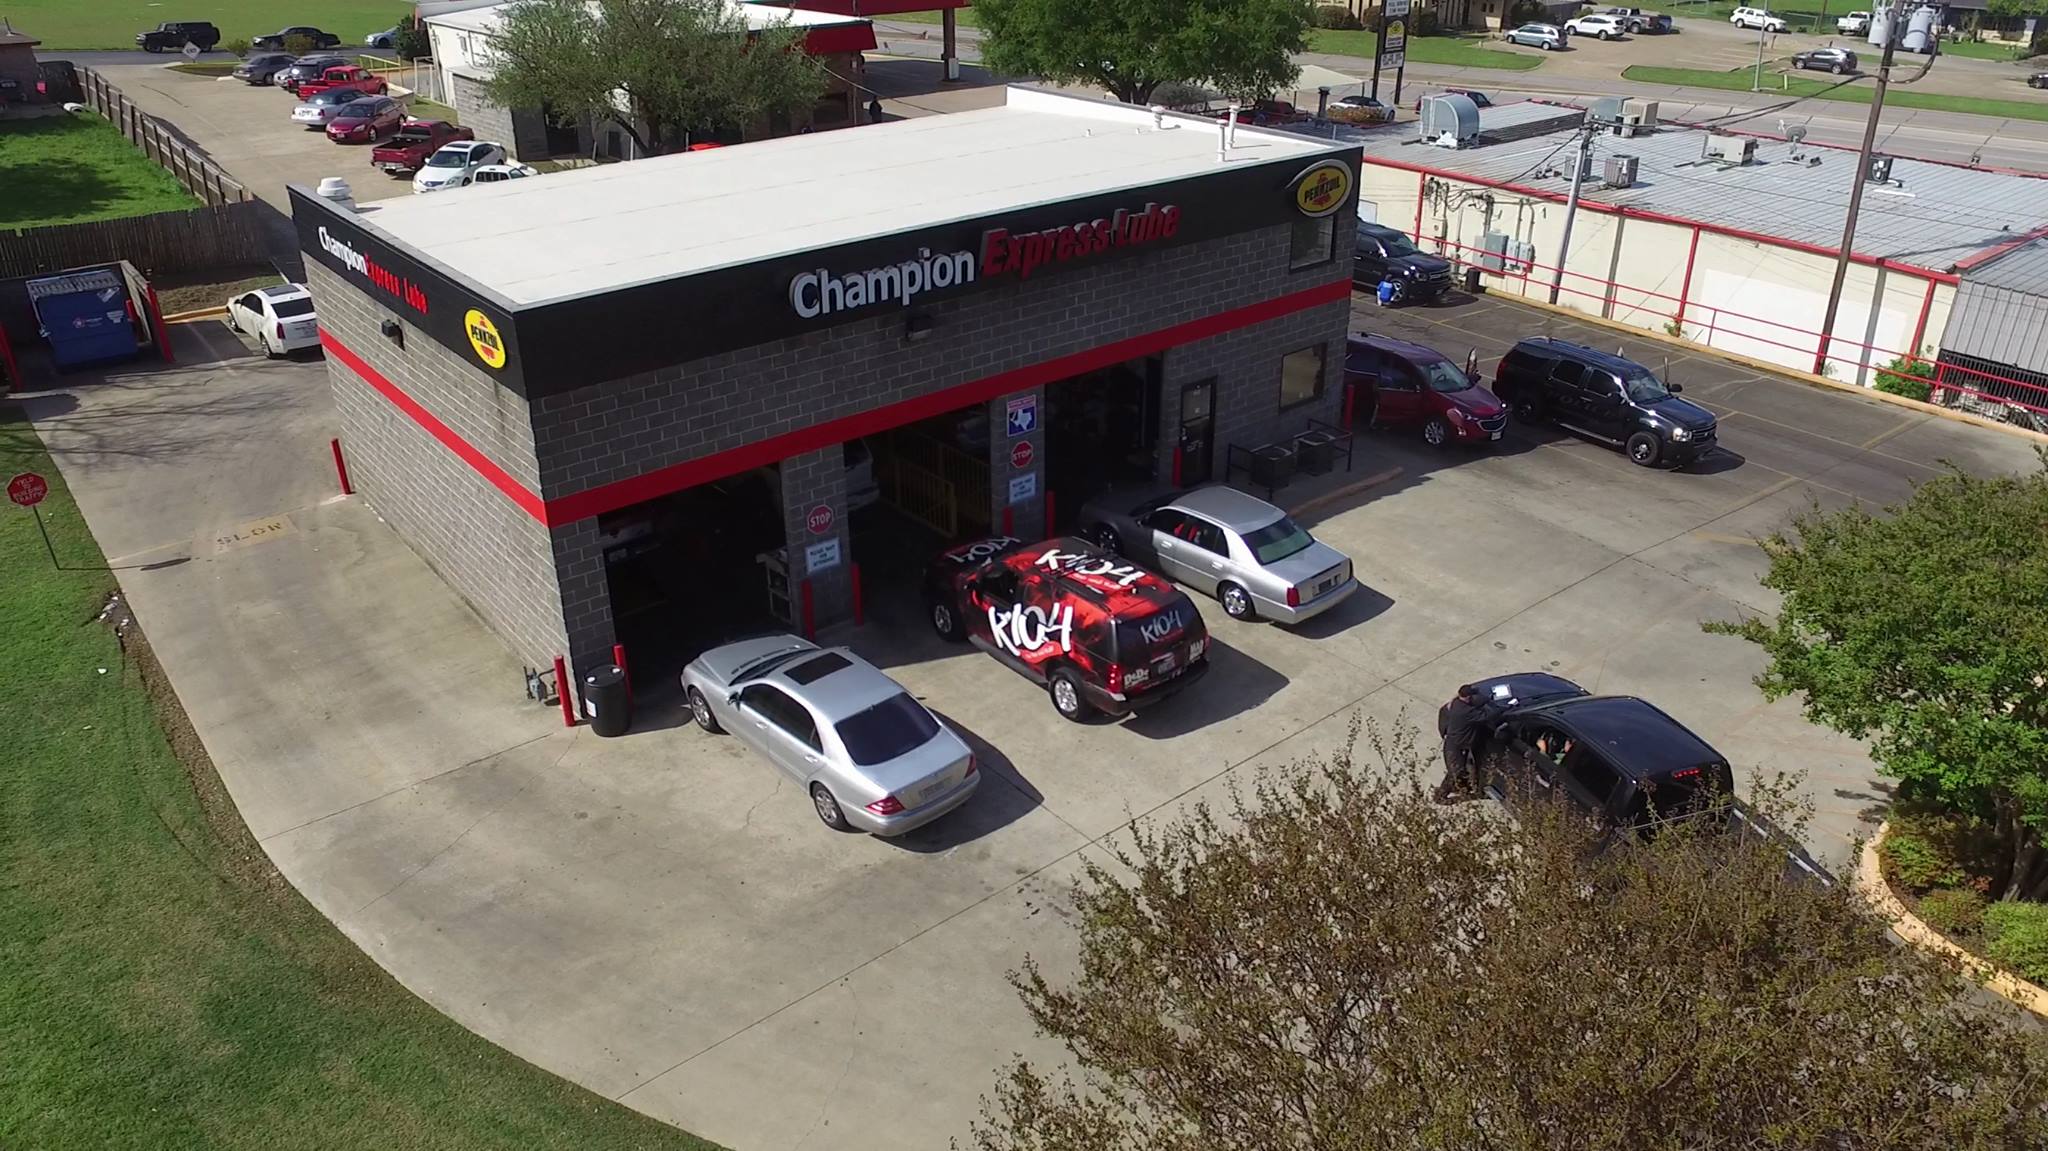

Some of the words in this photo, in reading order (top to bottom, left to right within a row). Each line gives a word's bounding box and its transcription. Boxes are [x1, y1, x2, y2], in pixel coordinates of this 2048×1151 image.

[318, 226, 368, 276] Champion
[403, 277, 429, 315] Lube
[790, 248, 975, 319] Champion
[981, 219, 1111, 278] Express
[1112, 202, 1181, 246] Lube
[471, 324, 500, 351] PENNZOIL
[1012, 449, 1032, 461] STOP
[217, 522, 281, 546] SLOW
[810, 512, 831, 528] STOP
[1034, 549, 1147, 586] K104
[988, 602, 1074, 657] K104
[1140, 610, 1183, 644] K104
